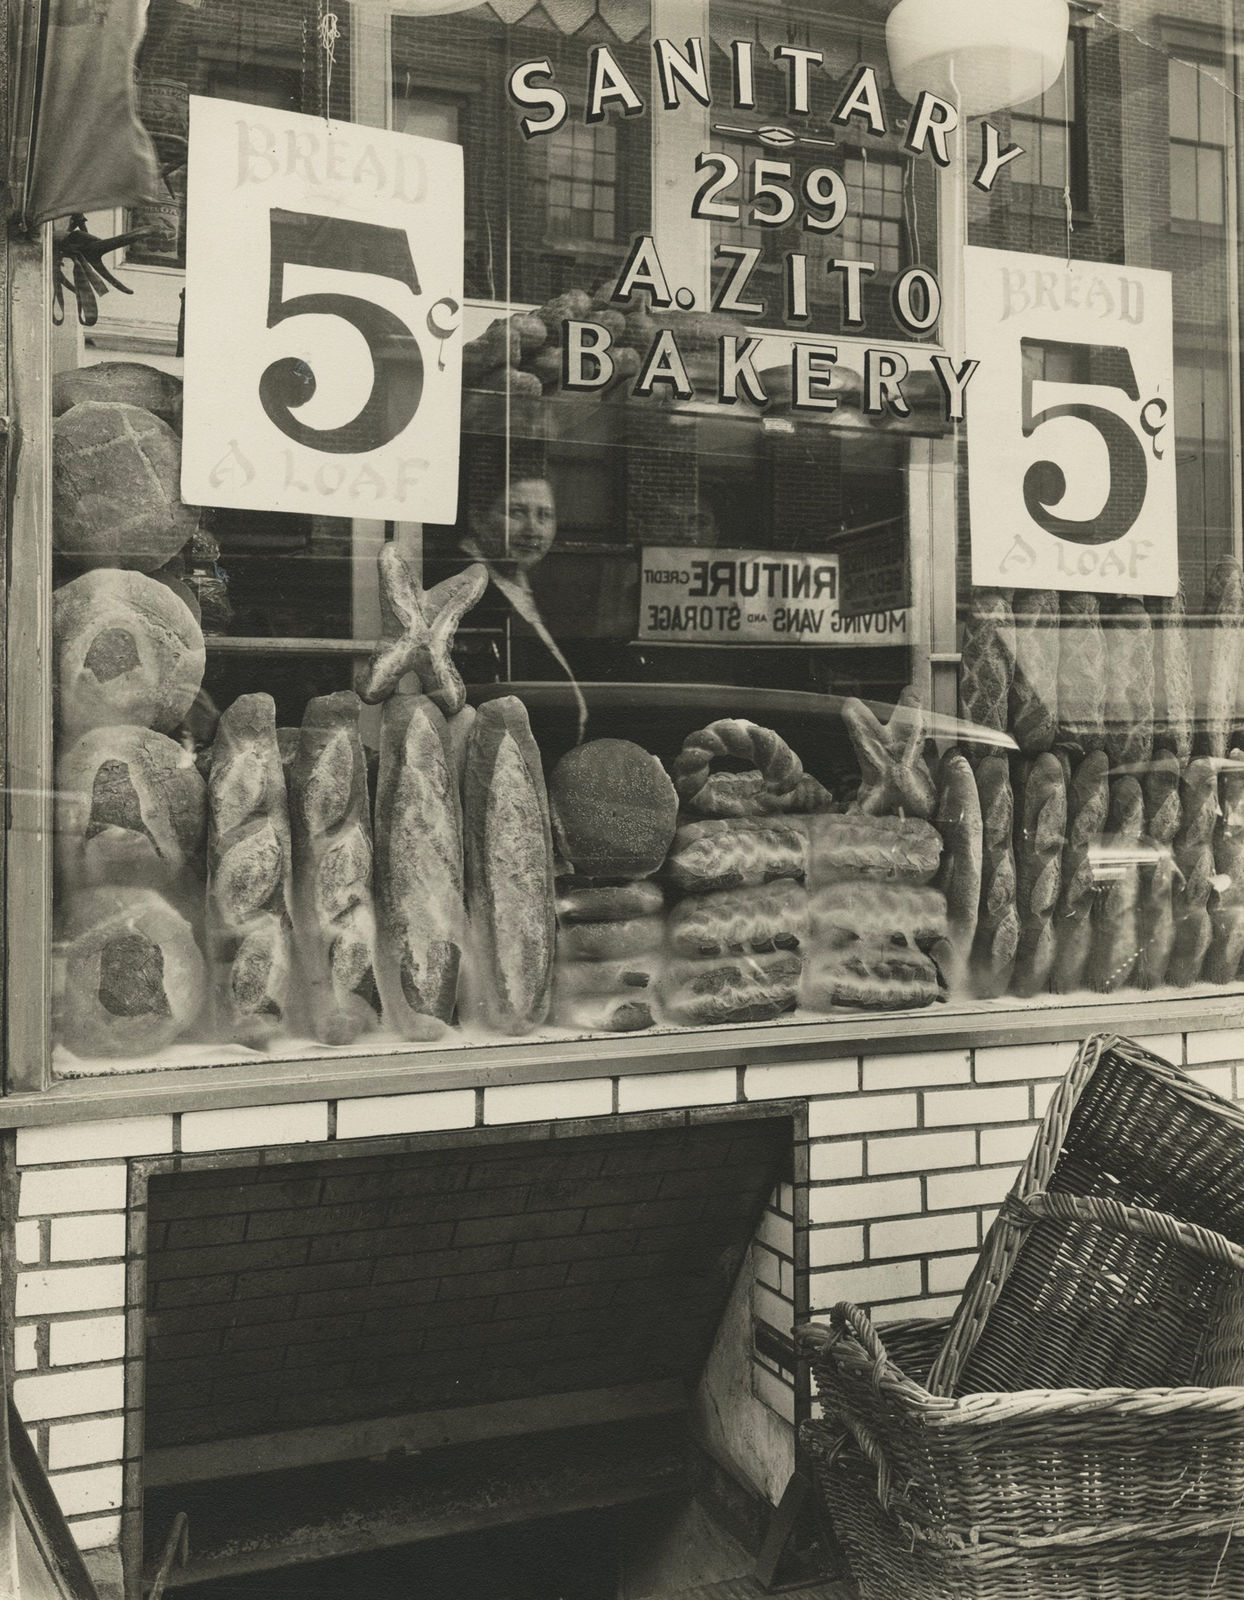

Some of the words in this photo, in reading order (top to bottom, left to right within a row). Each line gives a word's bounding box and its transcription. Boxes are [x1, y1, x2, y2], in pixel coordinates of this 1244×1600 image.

[508, 37, 1026, 192] SANITARY
[235, 119, 429, 204] BREAD
[691, 150, 848, 234] 259
[611, 235, 697, 311] A.
[711, 243, 943, 335] ZITO
[998, 266, 1145, 326] BREAD
[561, 319, 980, 422] BAKERY
[208, 438, 256, 490] A
[282, 447, 430, 503] LOAF
[998, 533, 1038, 575] A
[1053, 539, 1155, 579] LOAF
